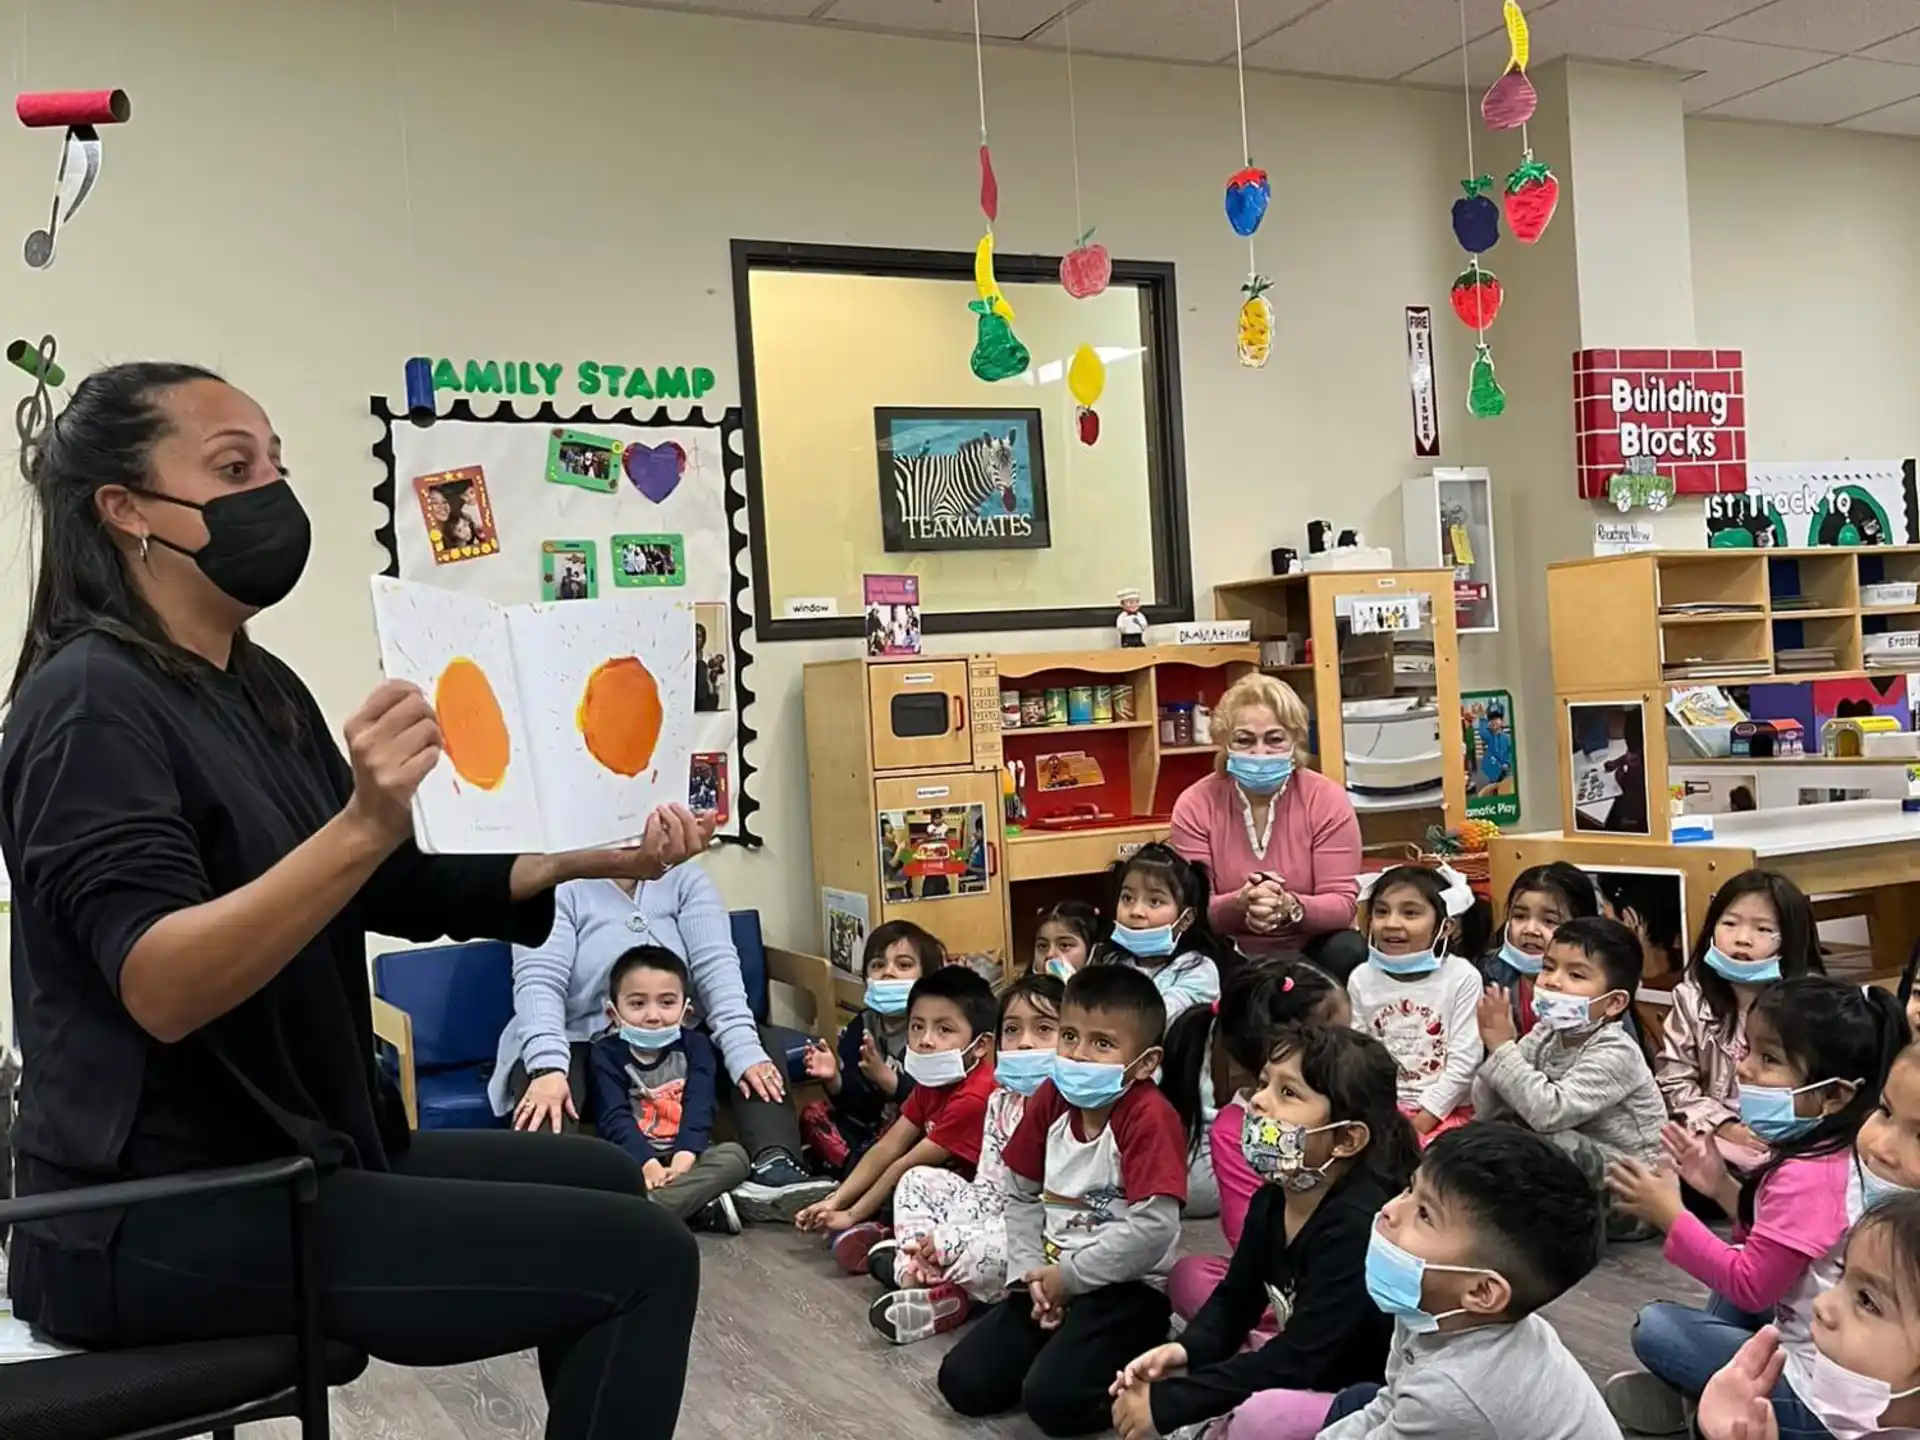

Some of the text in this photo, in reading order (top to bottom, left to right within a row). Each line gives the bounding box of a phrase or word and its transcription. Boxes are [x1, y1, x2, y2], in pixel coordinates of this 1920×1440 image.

[1409, 315, 1428, 329] FIRE
[428, 357, 715, 400] AMILY STAMP
[1415, 332, 1426, 441] EXTUISHER
[1611, 376, 1728, 426] Building
[1620, 421, 1717, 457] Blocks
[1745, 484, 1820, 518] Track
[1826, 487, 1851, 515] to
[902, 513, 1033, 539] TEAMMATES
[792, 603, 829, 614] window
